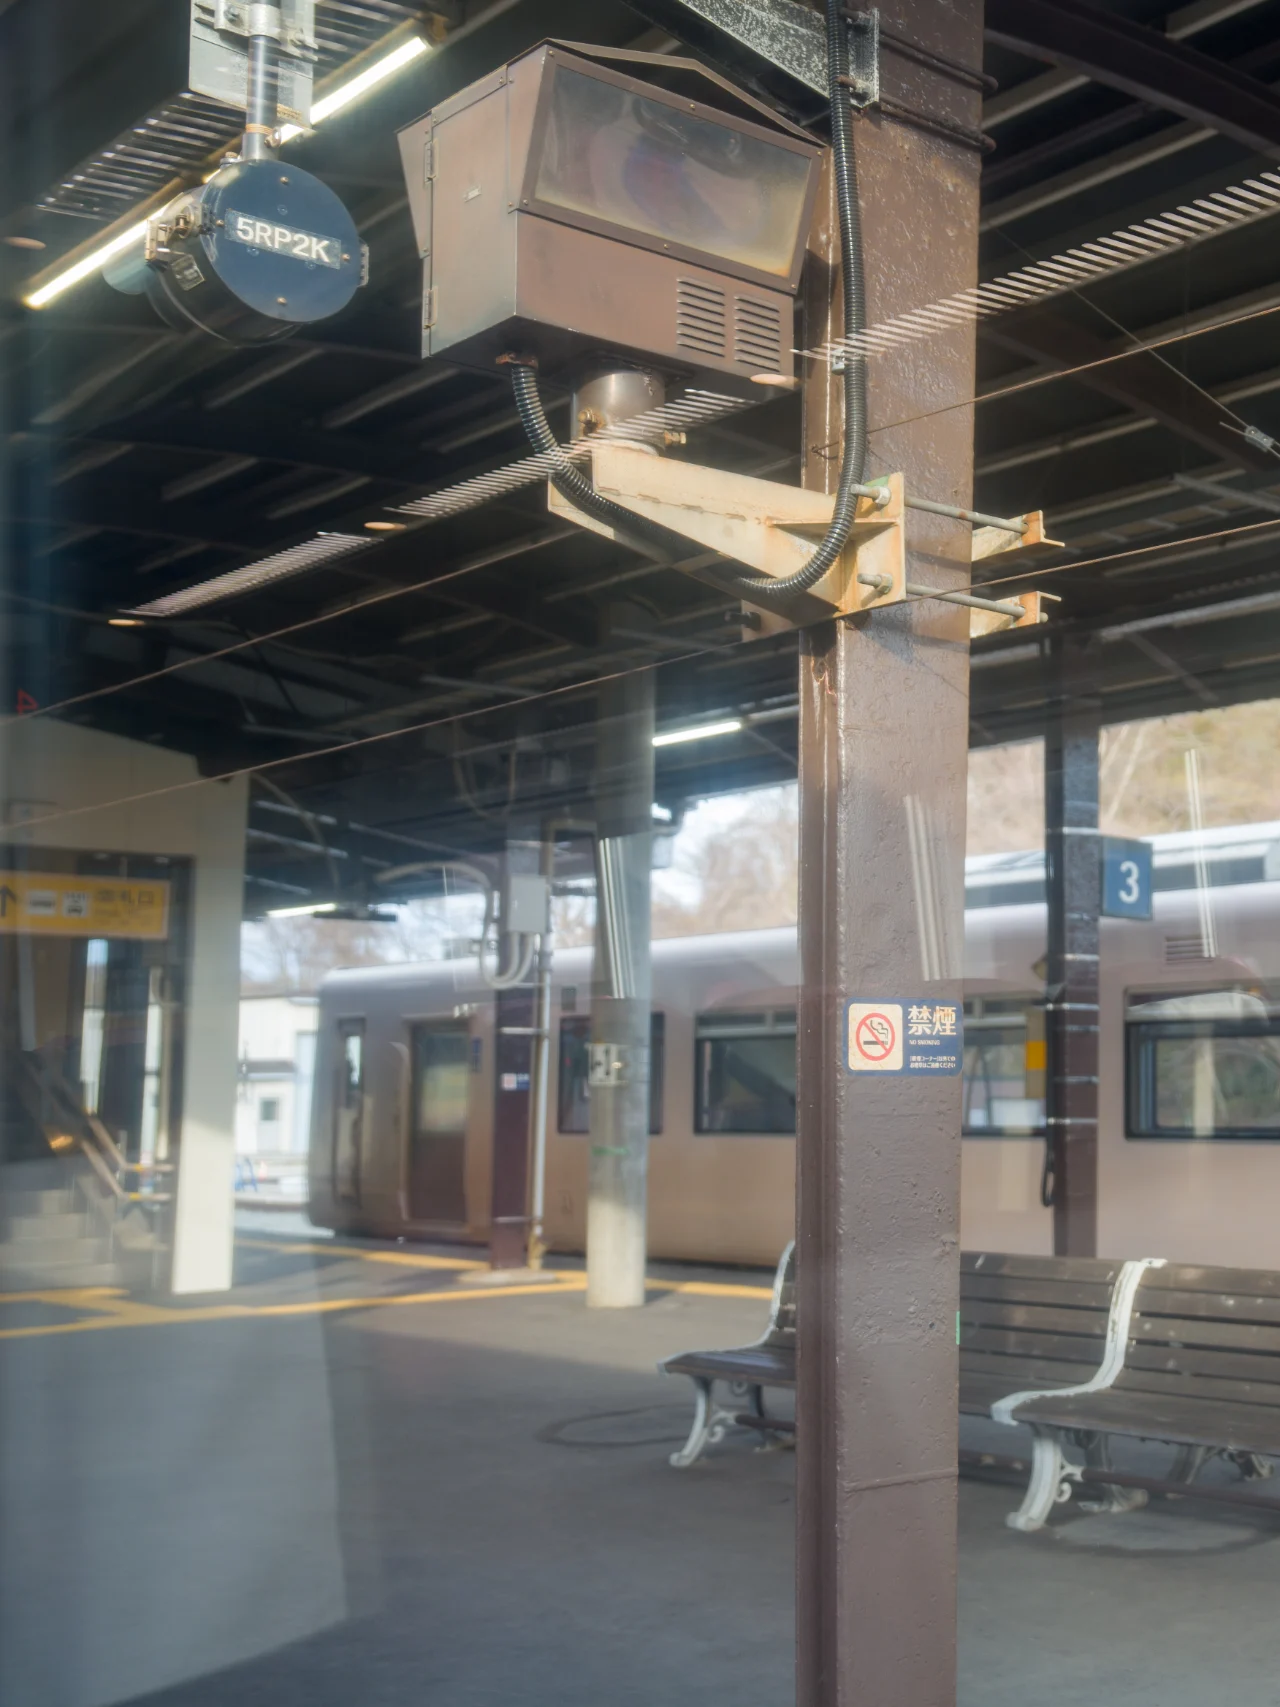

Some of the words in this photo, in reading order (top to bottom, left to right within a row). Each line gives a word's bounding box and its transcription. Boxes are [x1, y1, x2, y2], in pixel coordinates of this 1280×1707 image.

[236, 217, 330, 262] 5RP2K
[1118, 859, 1140, 905] 3
[907, 1004, 957, 1036] 禁煙
